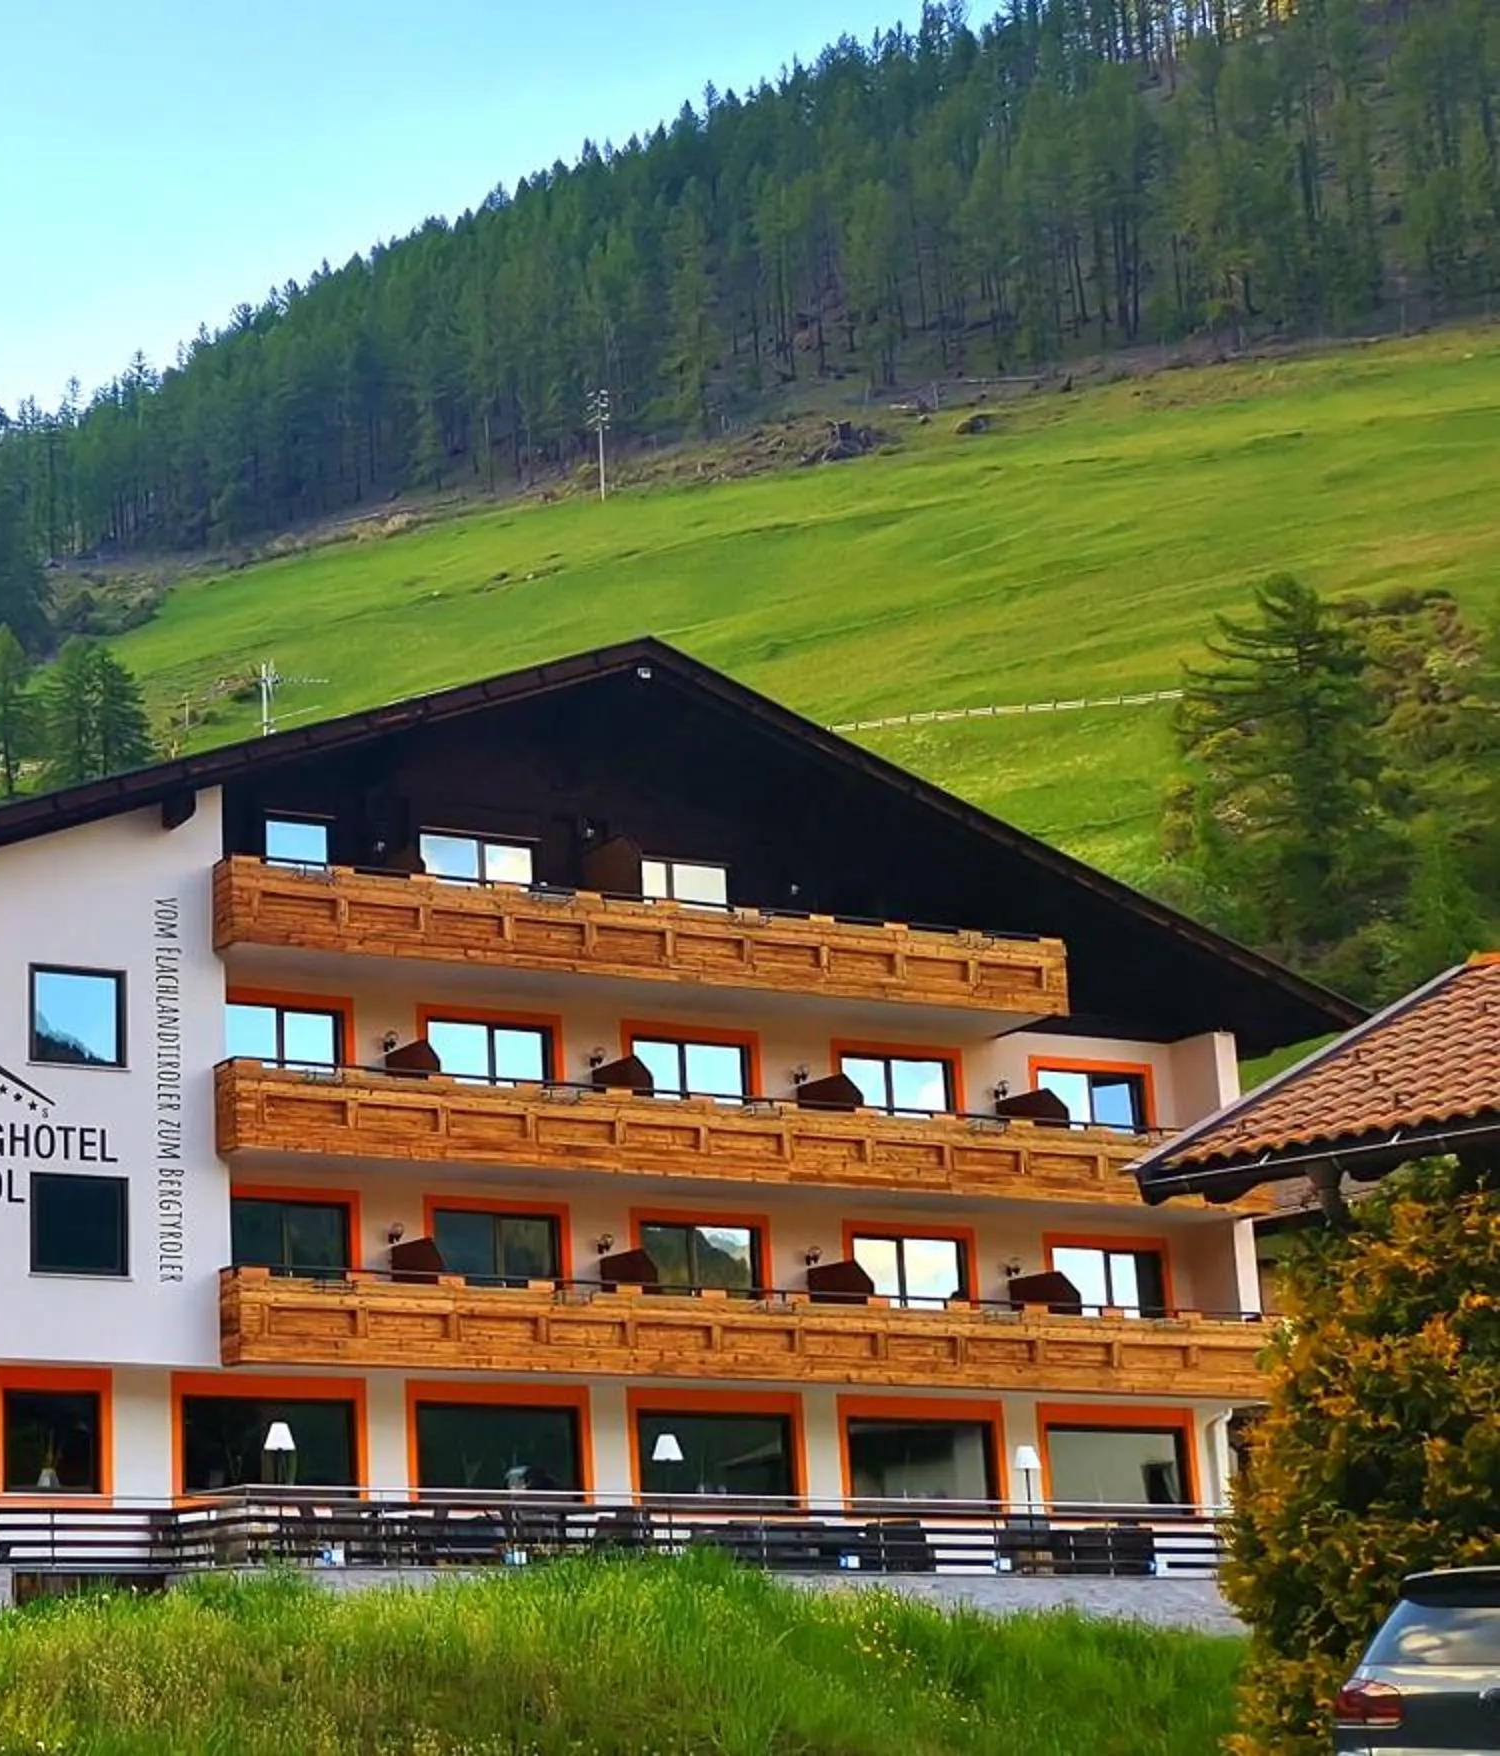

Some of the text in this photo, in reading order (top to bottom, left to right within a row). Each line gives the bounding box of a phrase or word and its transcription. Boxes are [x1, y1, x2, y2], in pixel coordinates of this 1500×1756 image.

[154, 897, 185, 1283] VOM FLACHLANDTIROLER ZUM BERGTYROLER
